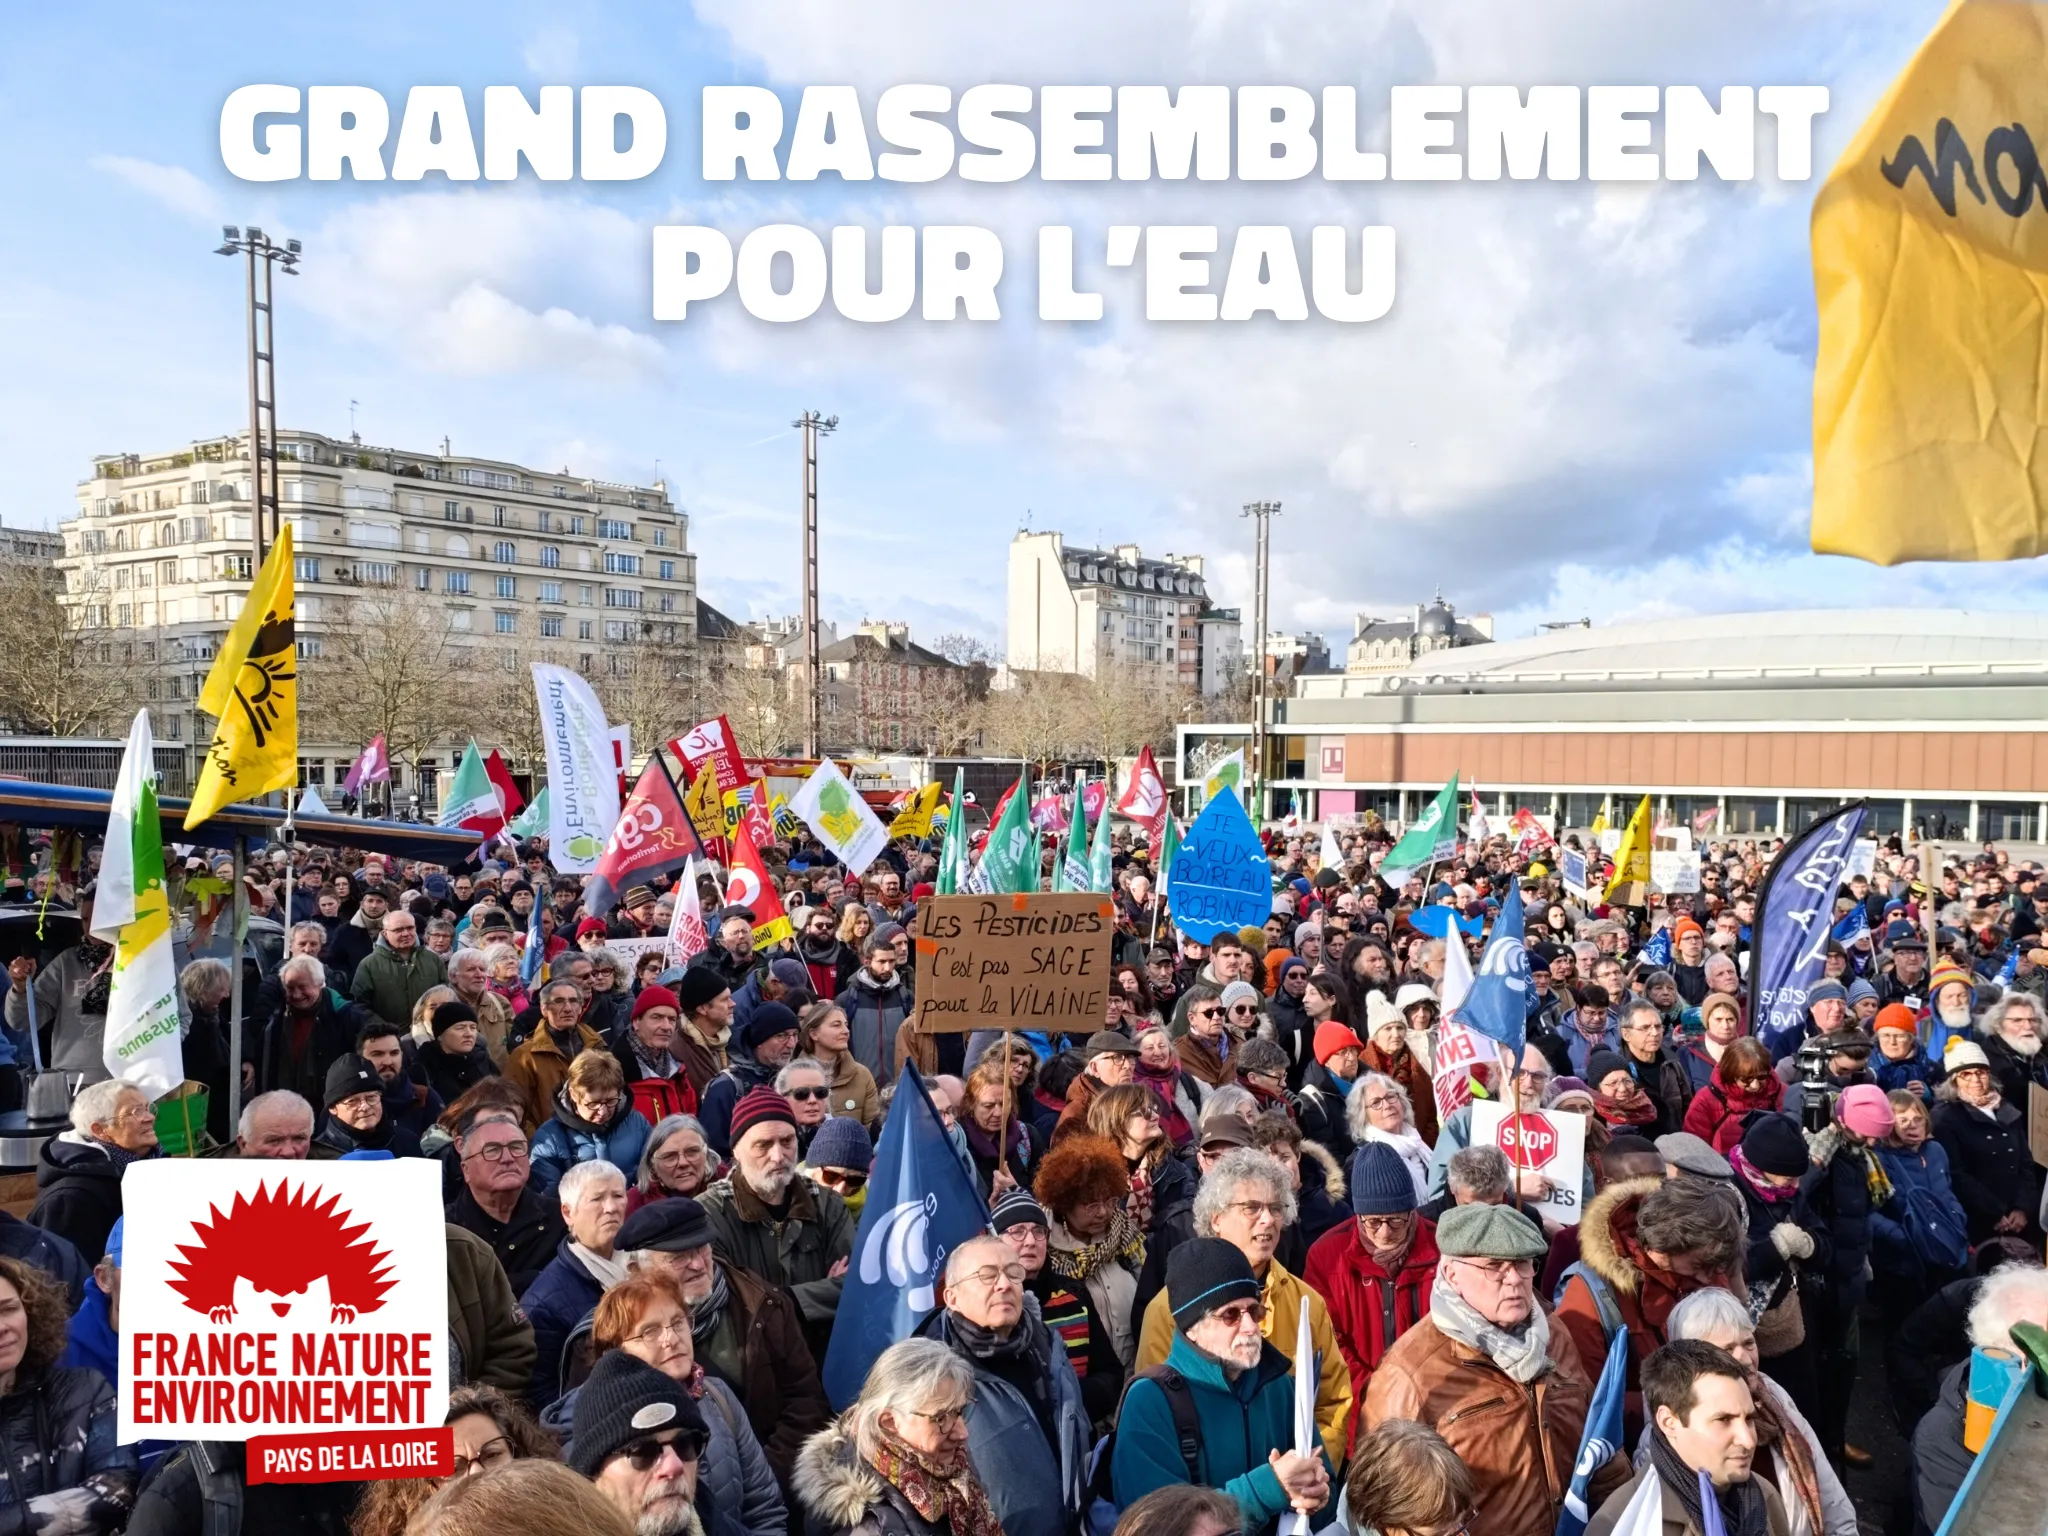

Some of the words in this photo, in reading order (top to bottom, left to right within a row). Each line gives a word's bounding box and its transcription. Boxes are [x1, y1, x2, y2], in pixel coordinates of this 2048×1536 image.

[1209, 812, 1237, 836] JE
[1194, 839, 1253, 867] VEUX
[1173, 857, 1238, 886] BOIRE
[1238, 867, 1266, 893] AU
[922, 911, 962, 939] LES
[973, 901, 1102, 937] PESTICIDES
[1175, 890, 1271, 925] ROBINET
[931, 946, 976, 979] C'est
[979, 957, 1010, 984] pas
[1023, 947, 1095, 976] SAGE
[919, 996, 970, 1028] pour
[977, 985, 999, 1015] la
[1009, 984, 1101, 1017] VILAINE
